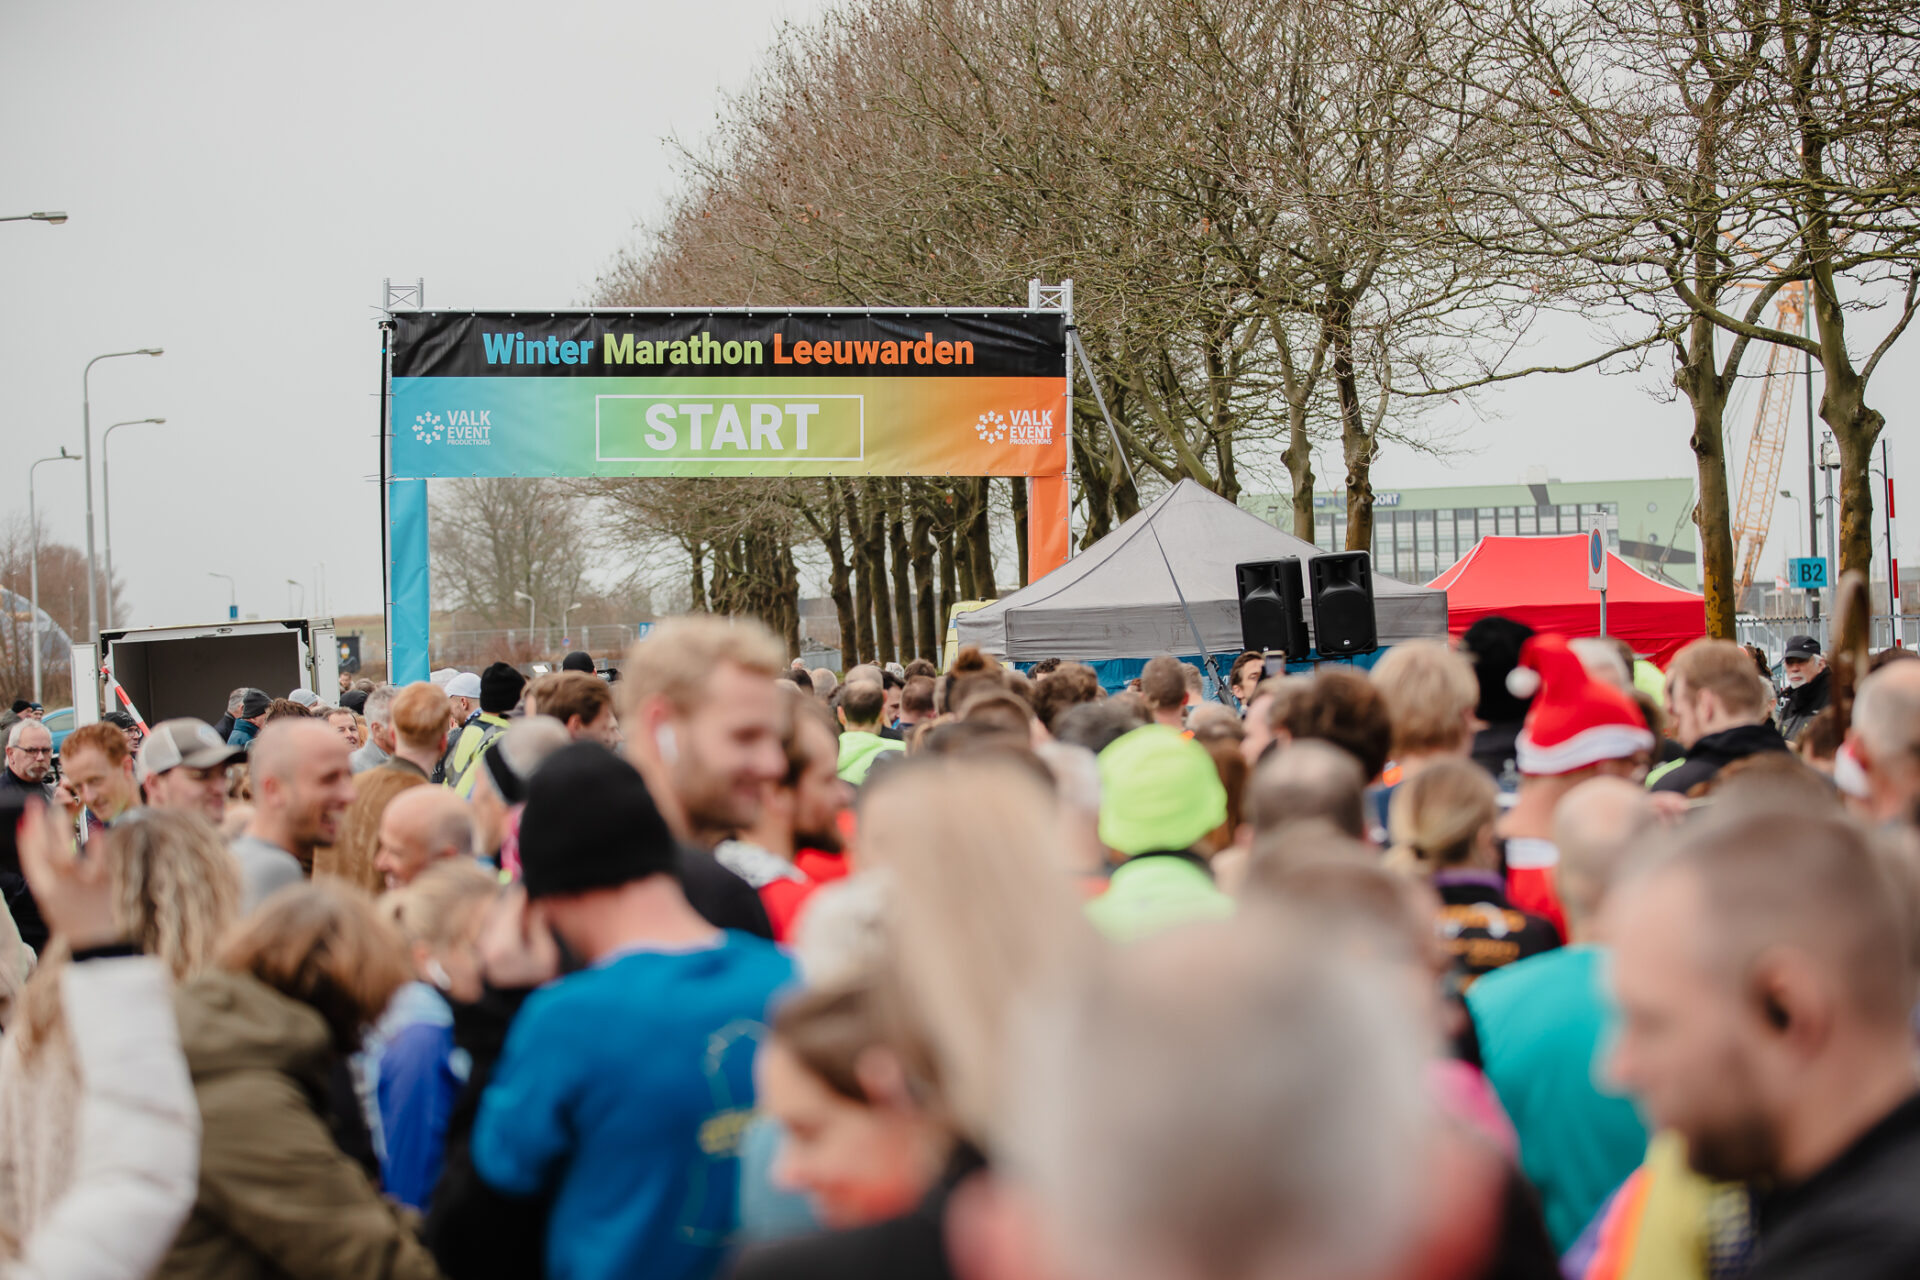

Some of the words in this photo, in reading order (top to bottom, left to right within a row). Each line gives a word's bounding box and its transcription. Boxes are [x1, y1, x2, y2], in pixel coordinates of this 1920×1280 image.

[482, 332, 594, 365] Winter
[603, 331, 763, 365] Marathon
[773, 331, 975, 365] Leeuwarden
[446, 409, 492, 426] VALK
[1009, 409, 1053, 426] VALK
[447, 426, 491, 439] EVENT
[643, 402, 820, 451] START
[1009, 425, 1053, 439] EVENT
[446, 438, 492, 446] PRODUCTIONS
[1009, 438, 1053, 446] PRODUCTIONS
[1800, 563, 1824, 582] B2
